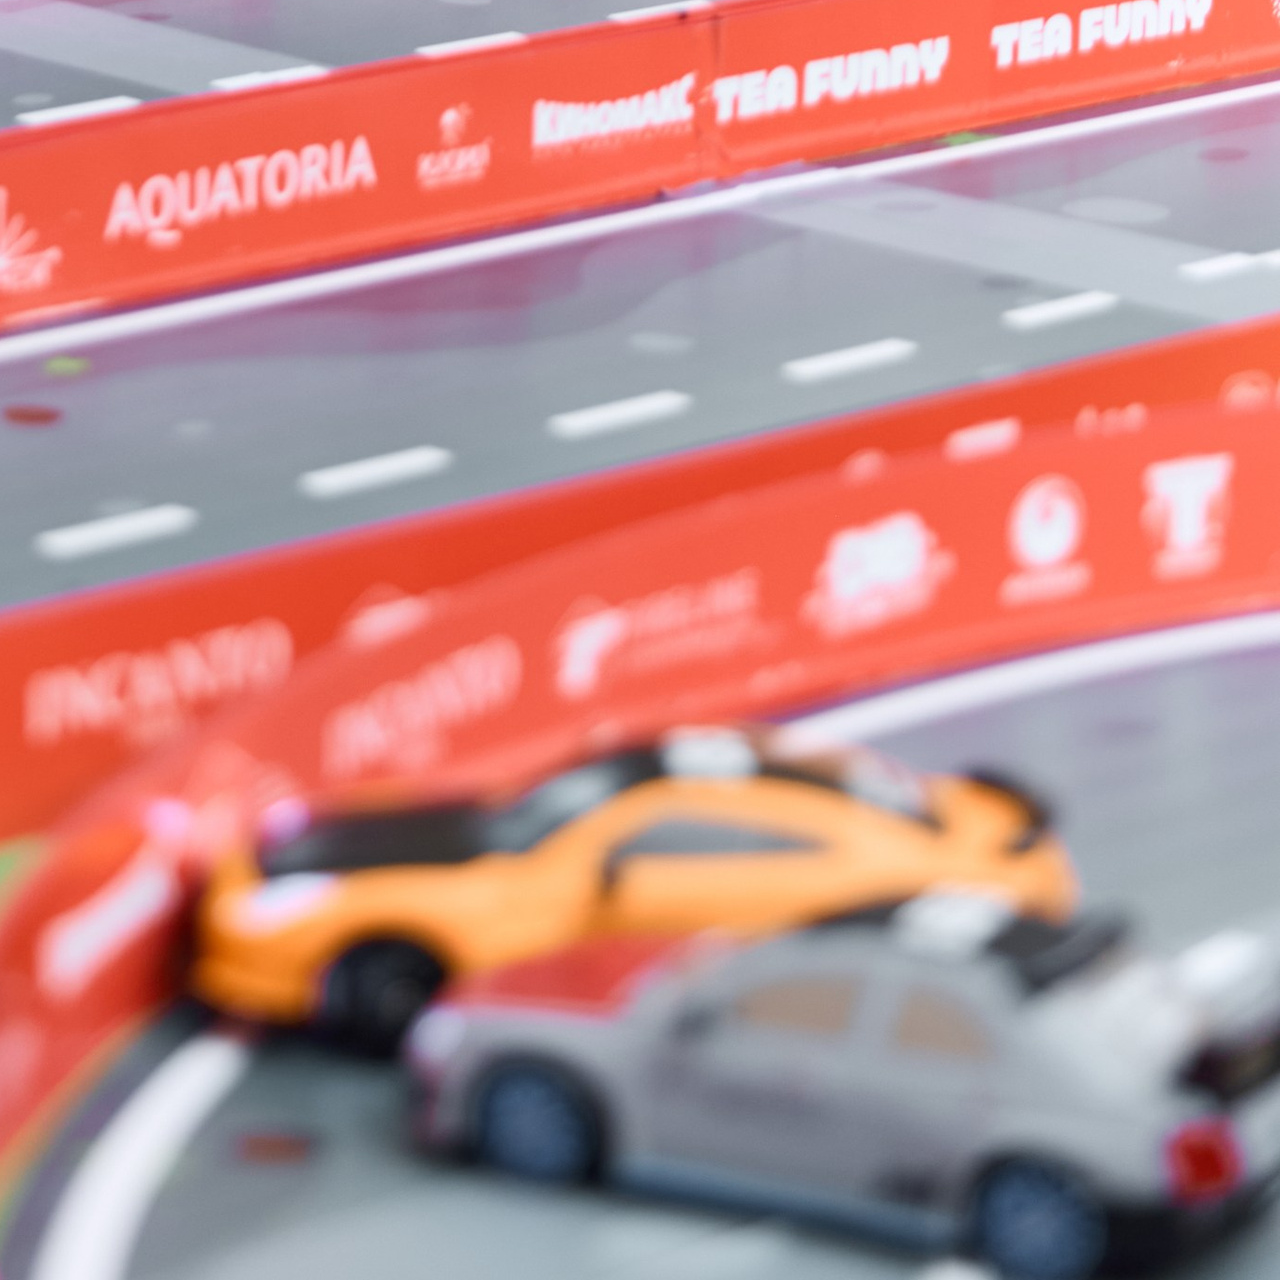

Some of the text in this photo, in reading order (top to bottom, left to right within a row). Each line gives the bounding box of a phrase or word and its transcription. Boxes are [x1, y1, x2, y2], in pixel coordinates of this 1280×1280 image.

[713, 35, 951, 126] TEA FUNNY
[990, 12, 1073, 69] TEA
[103, 133, 379, 247] AQUATORIA
